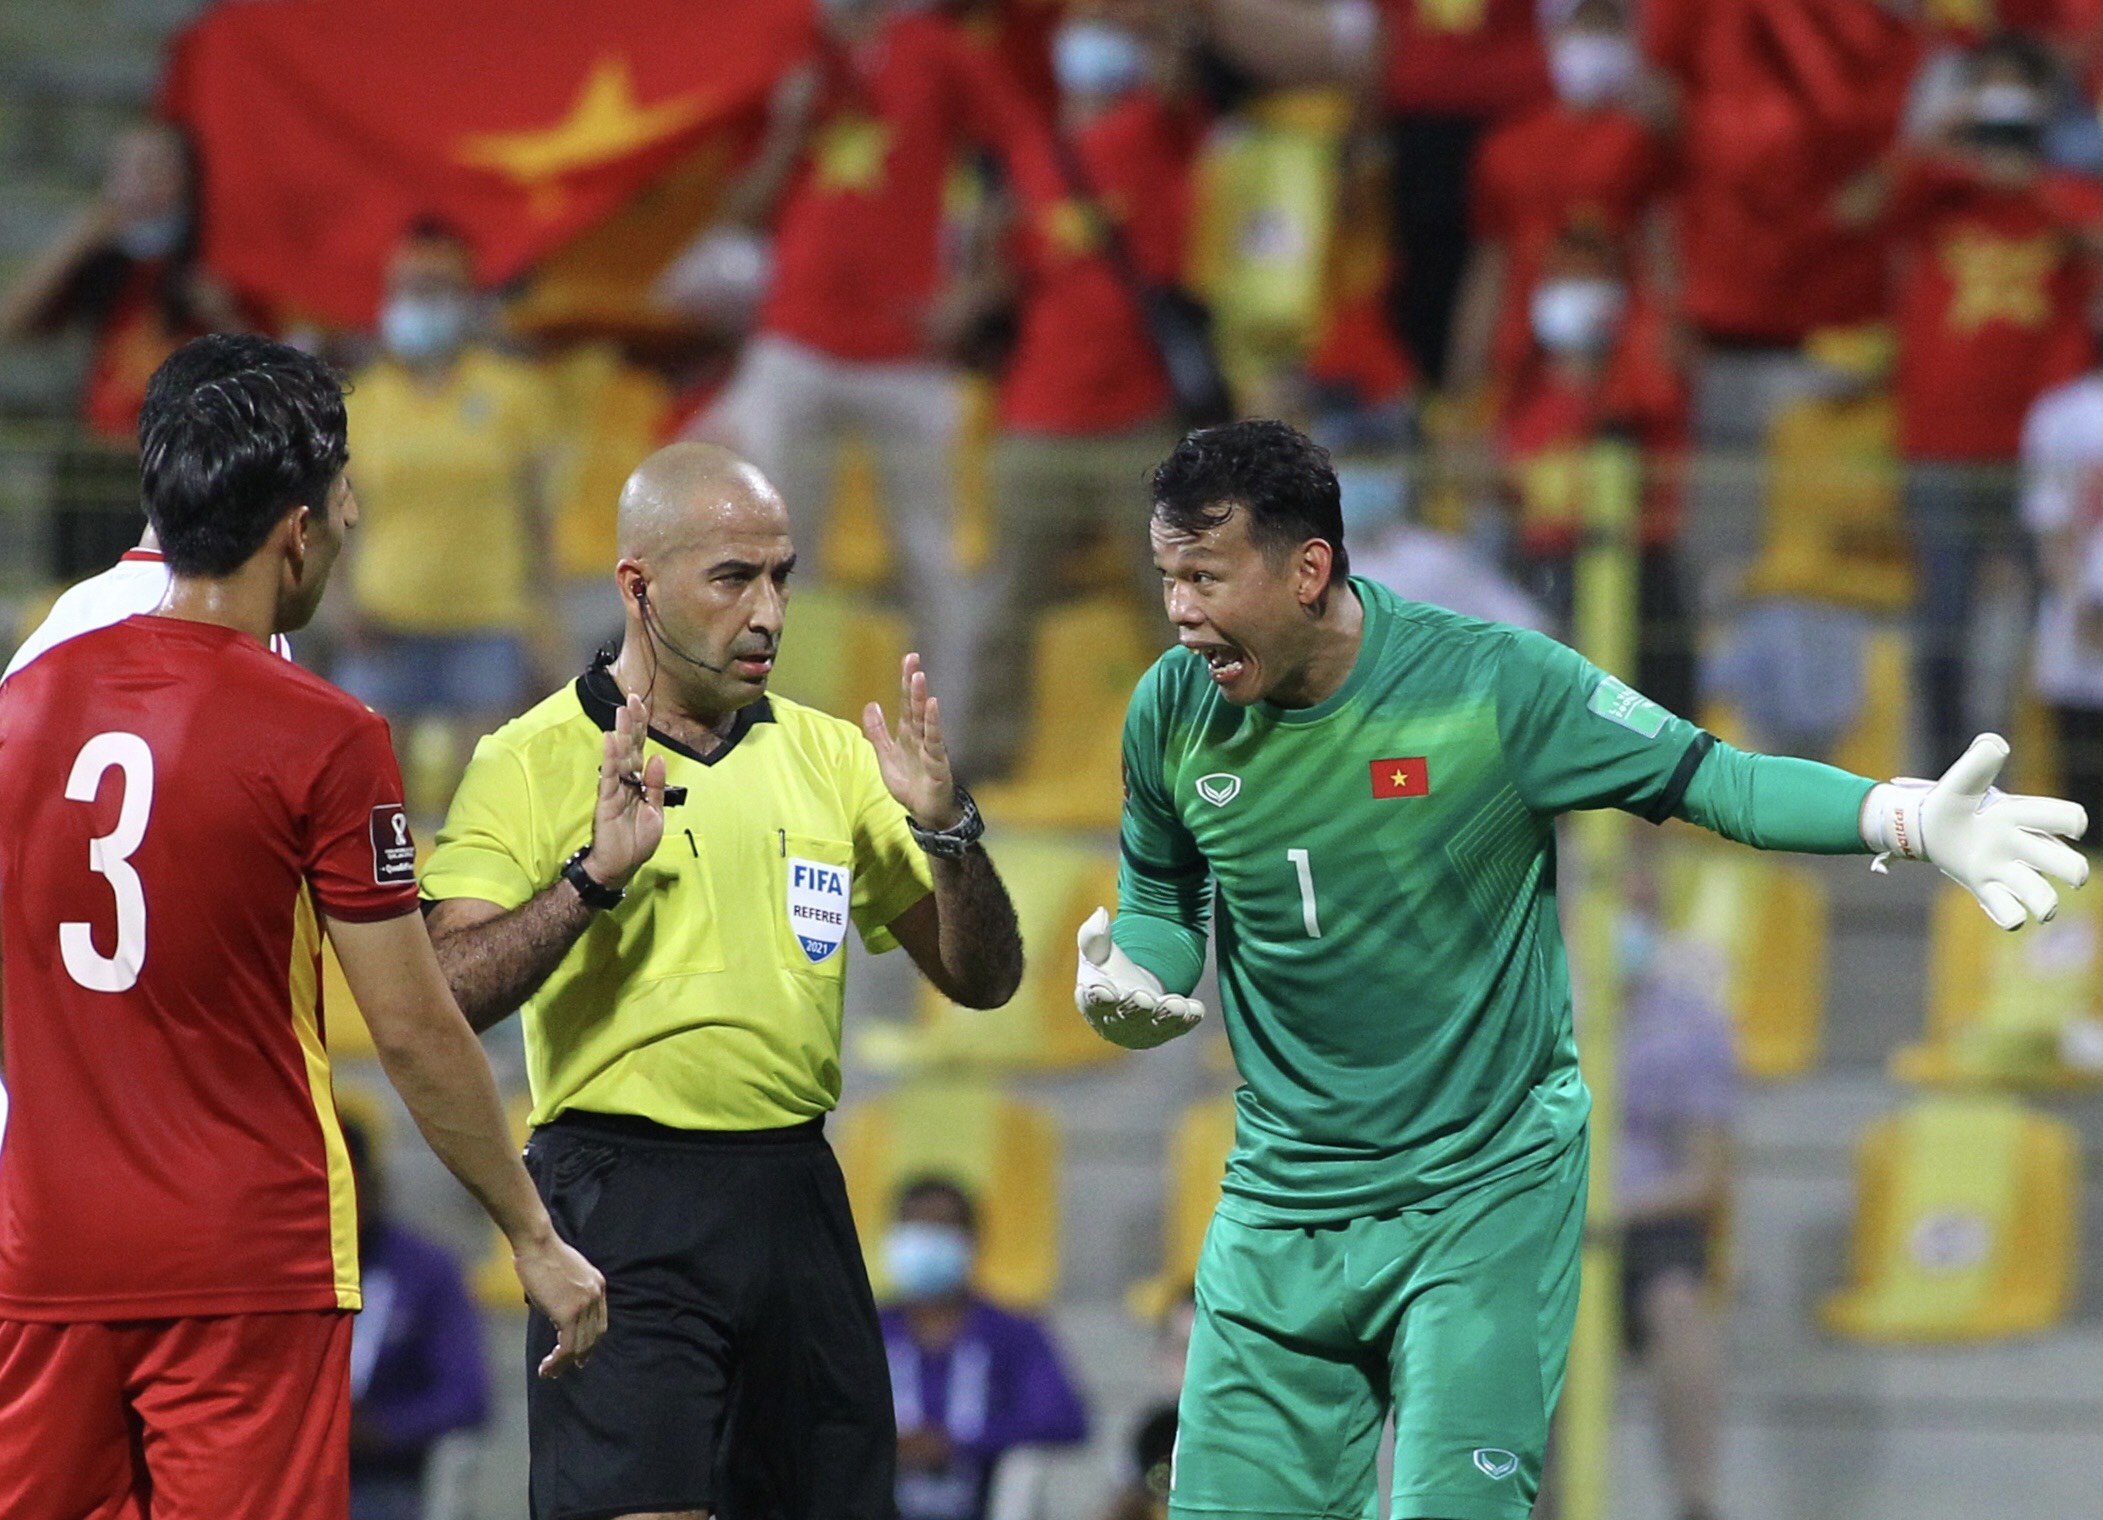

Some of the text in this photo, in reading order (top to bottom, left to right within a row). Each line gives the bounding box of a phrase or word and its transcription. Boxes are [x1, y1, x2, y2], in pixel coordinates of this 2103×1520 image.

[59, 731, 154, 992] 3
[794, 865, 843, 896] FIFA
[1287, 848, 1321, 938] 1
[793, 904, 843, 926] REFEREE
[806, 940, 828, 955] 2021
